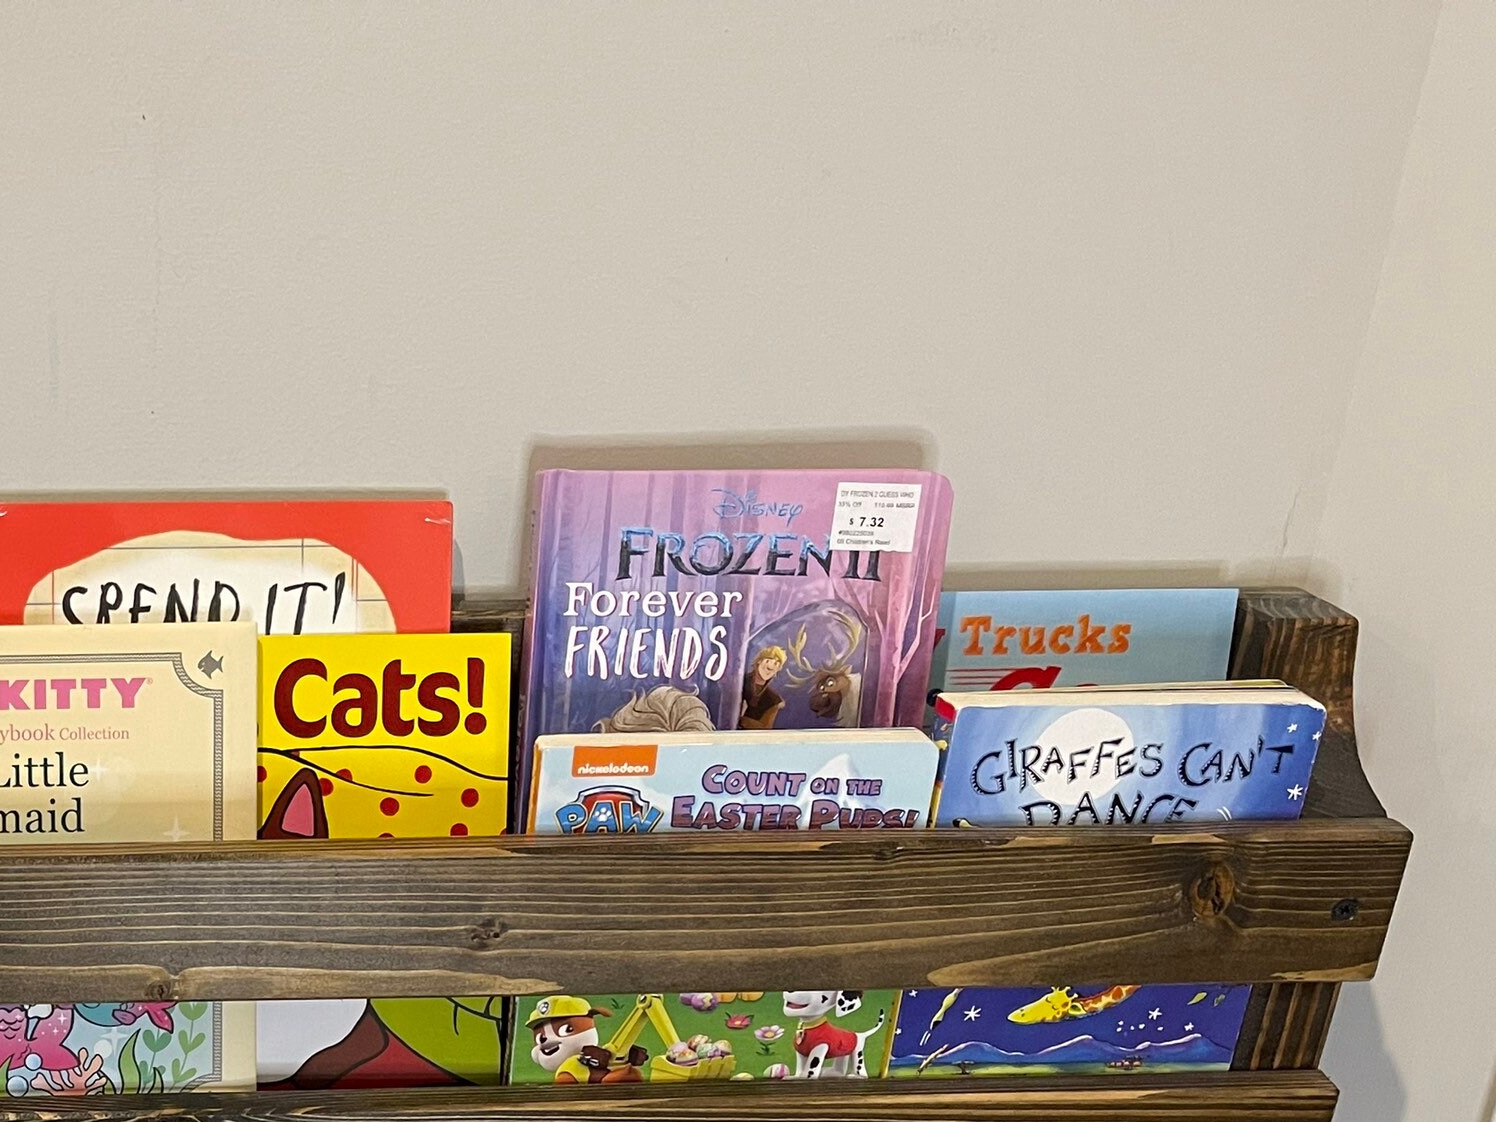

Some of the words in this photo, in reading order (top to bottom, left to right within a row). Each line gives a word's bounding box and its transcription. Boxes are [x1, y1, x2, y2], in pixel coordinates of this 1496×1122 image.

[859, 516, 884, 527] 7.32
[615, 526, 833, 581] FROZEN
[62, 577, 241, 625] SPEND
[264, 571, 346, 636] IT!
[563, 582, 743, 618] Forever
[564, 625, 729, 682] FRIENDS
[959, 614, 1132, 657] Trucks
[273, 656, 488, 738] Cats!
[59, 726, 130, 741] Collection
[578, 762, 649, 774] nickelodeon
[702, 764, 807, 797] COUNT
[810, 777, 838, 795] ON
[846, 778, 882, 797] THE
[970, 736, 1164, 796] GIRAFFES
[1177, 735, 1295, 788] CAN'T
[555, 800, 665, 833] PAW
[671, 796, 802, 830] EASTER
[1019, 791, 1199, 827] DANCE
